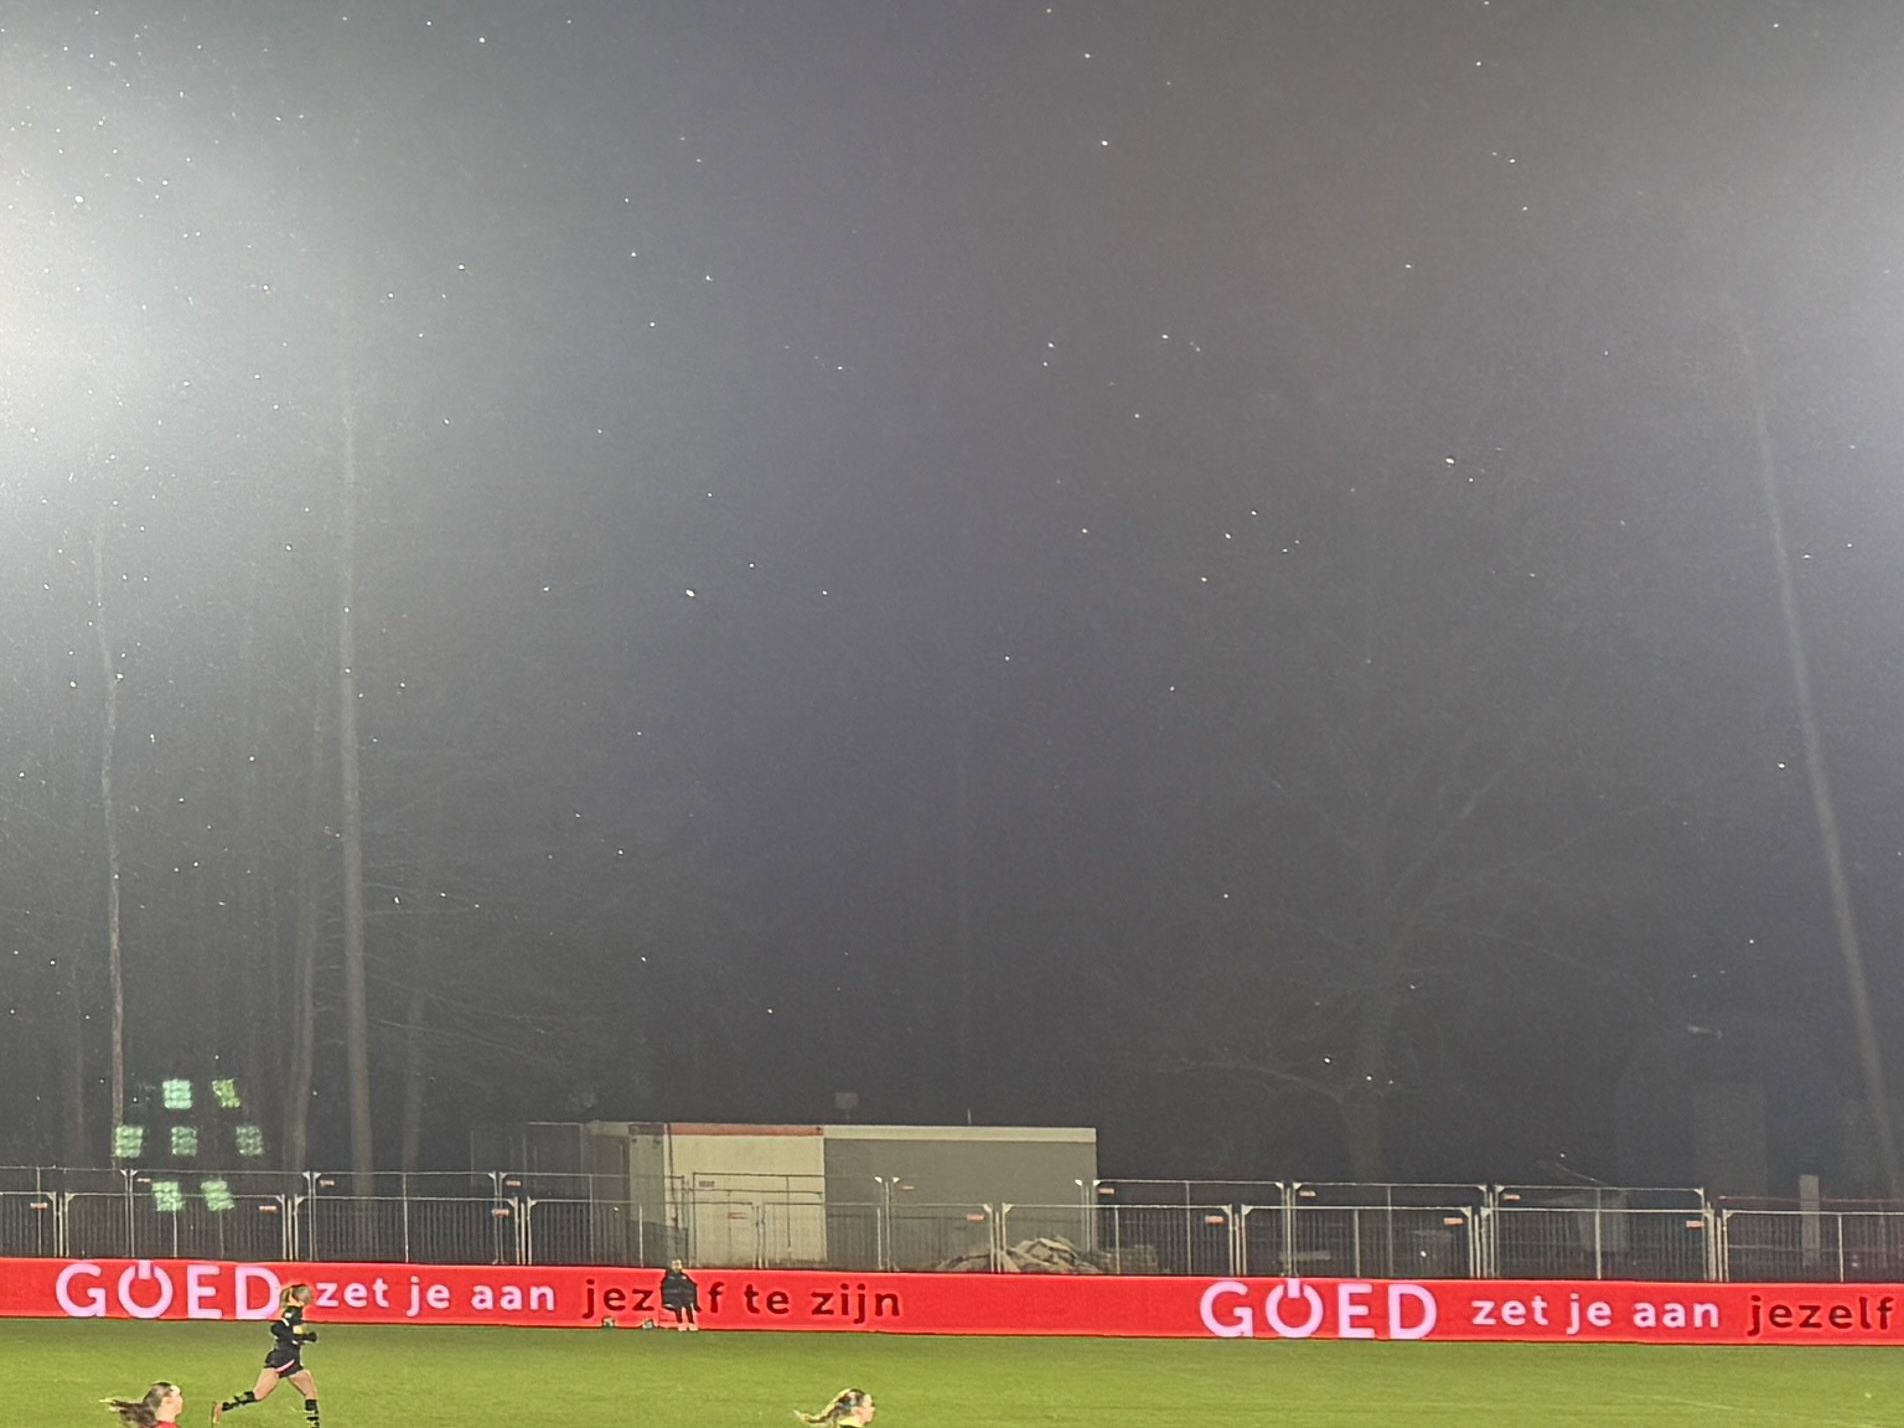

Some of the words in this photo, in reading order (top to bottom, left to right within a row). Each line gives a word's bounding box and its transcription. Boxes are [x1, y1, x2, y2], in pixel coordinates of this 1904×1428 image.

[56, 1259, 280, 1320] GOED
[315, 1277, 389, 1308] zet
[406, 1275, 450, 1317] je
[471, 1285, 554, 1311] aan
[580, 1277, 726, 1320] jezf
[743, 1283, 789, 1315] te
[811, 1283, 900, 1325] zijn
[1200, 1278, 1437, 1339] GOED
[1472, 1295, 1548, 1326] zet
[1566, 1293, 1611, 1335] je
[1633, 1302, 1719, 1328] aan
[1747, 1295, 1894, 1337] jezelf
